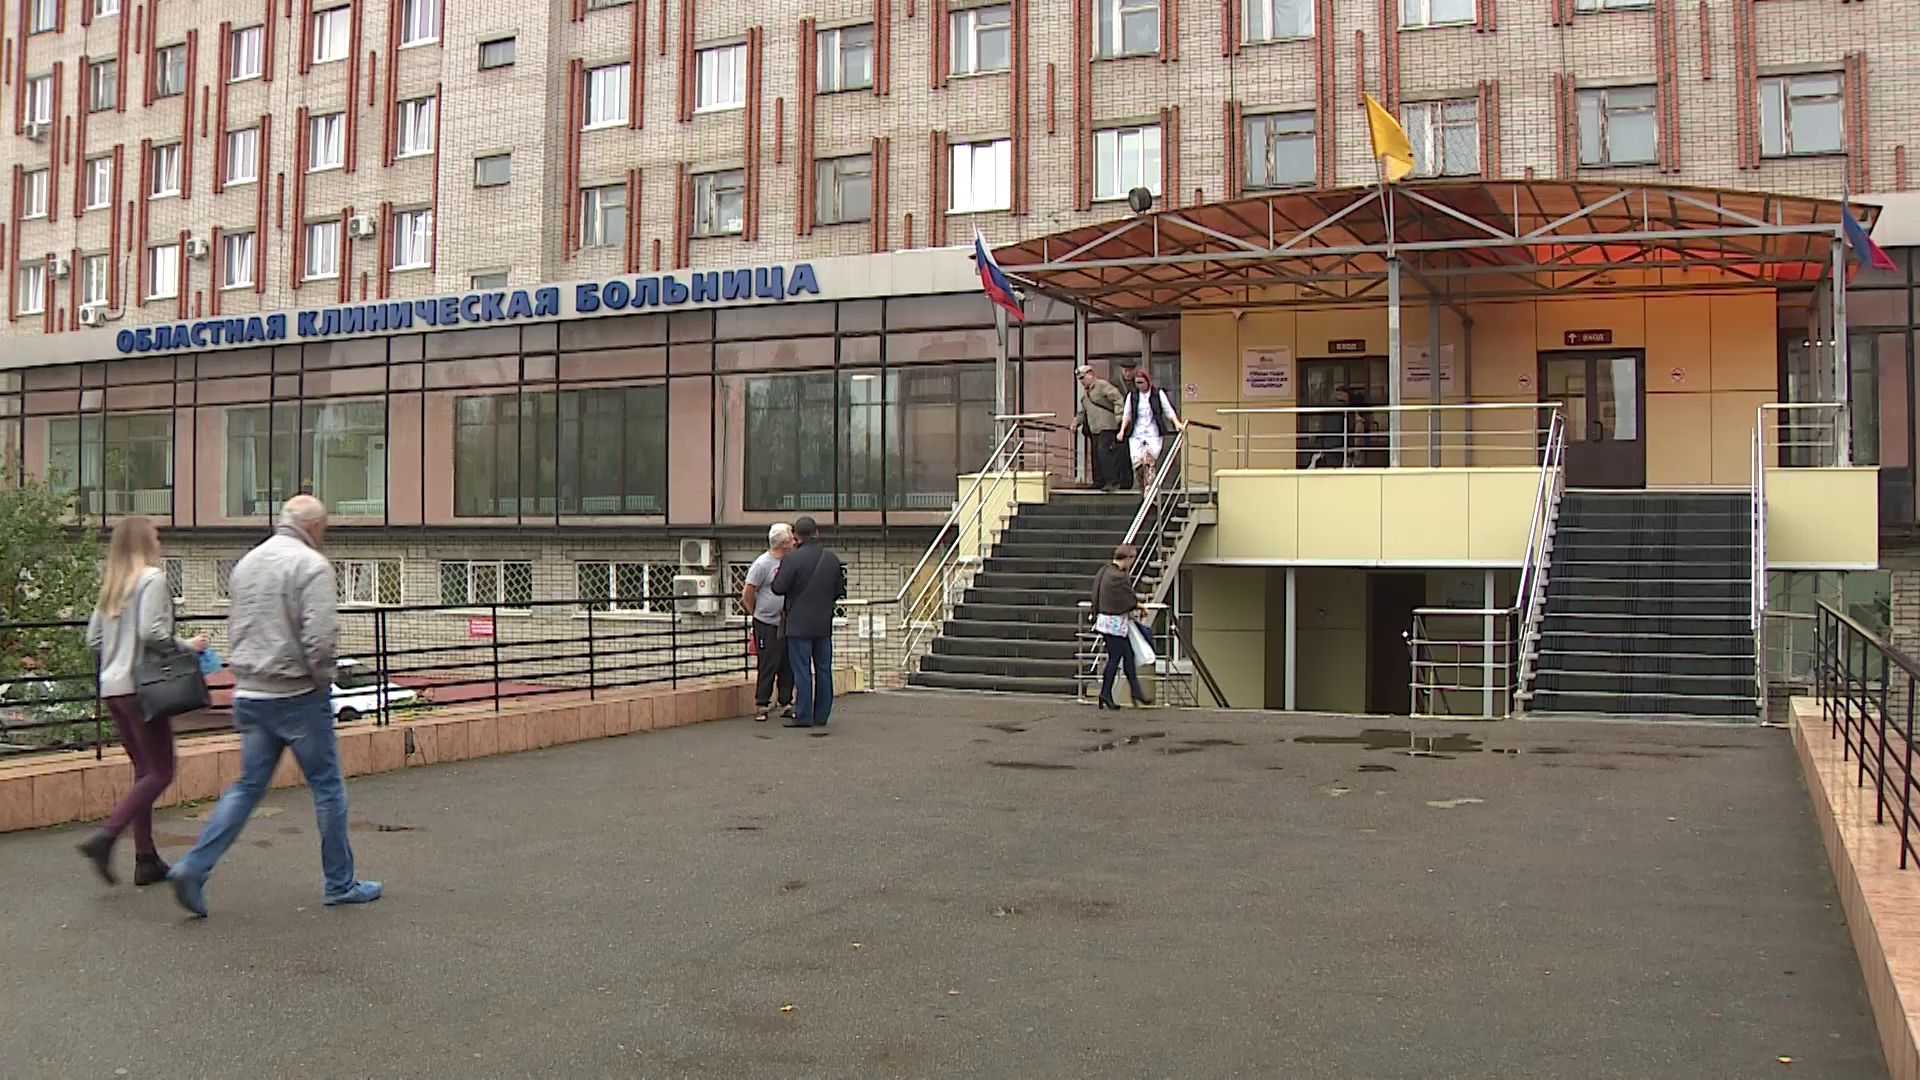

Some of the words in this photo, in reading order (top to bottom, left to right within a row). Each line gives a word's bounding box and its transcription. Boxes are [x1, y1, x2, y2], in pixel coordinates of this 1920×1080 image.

[117, 313, 287, 353] ОБЛАСТНАЯ
[297, 287, 559, 337] КЛИНИЧЕСКАЯ
[576, 263, 820, 312] БОЛЬНИЦА
